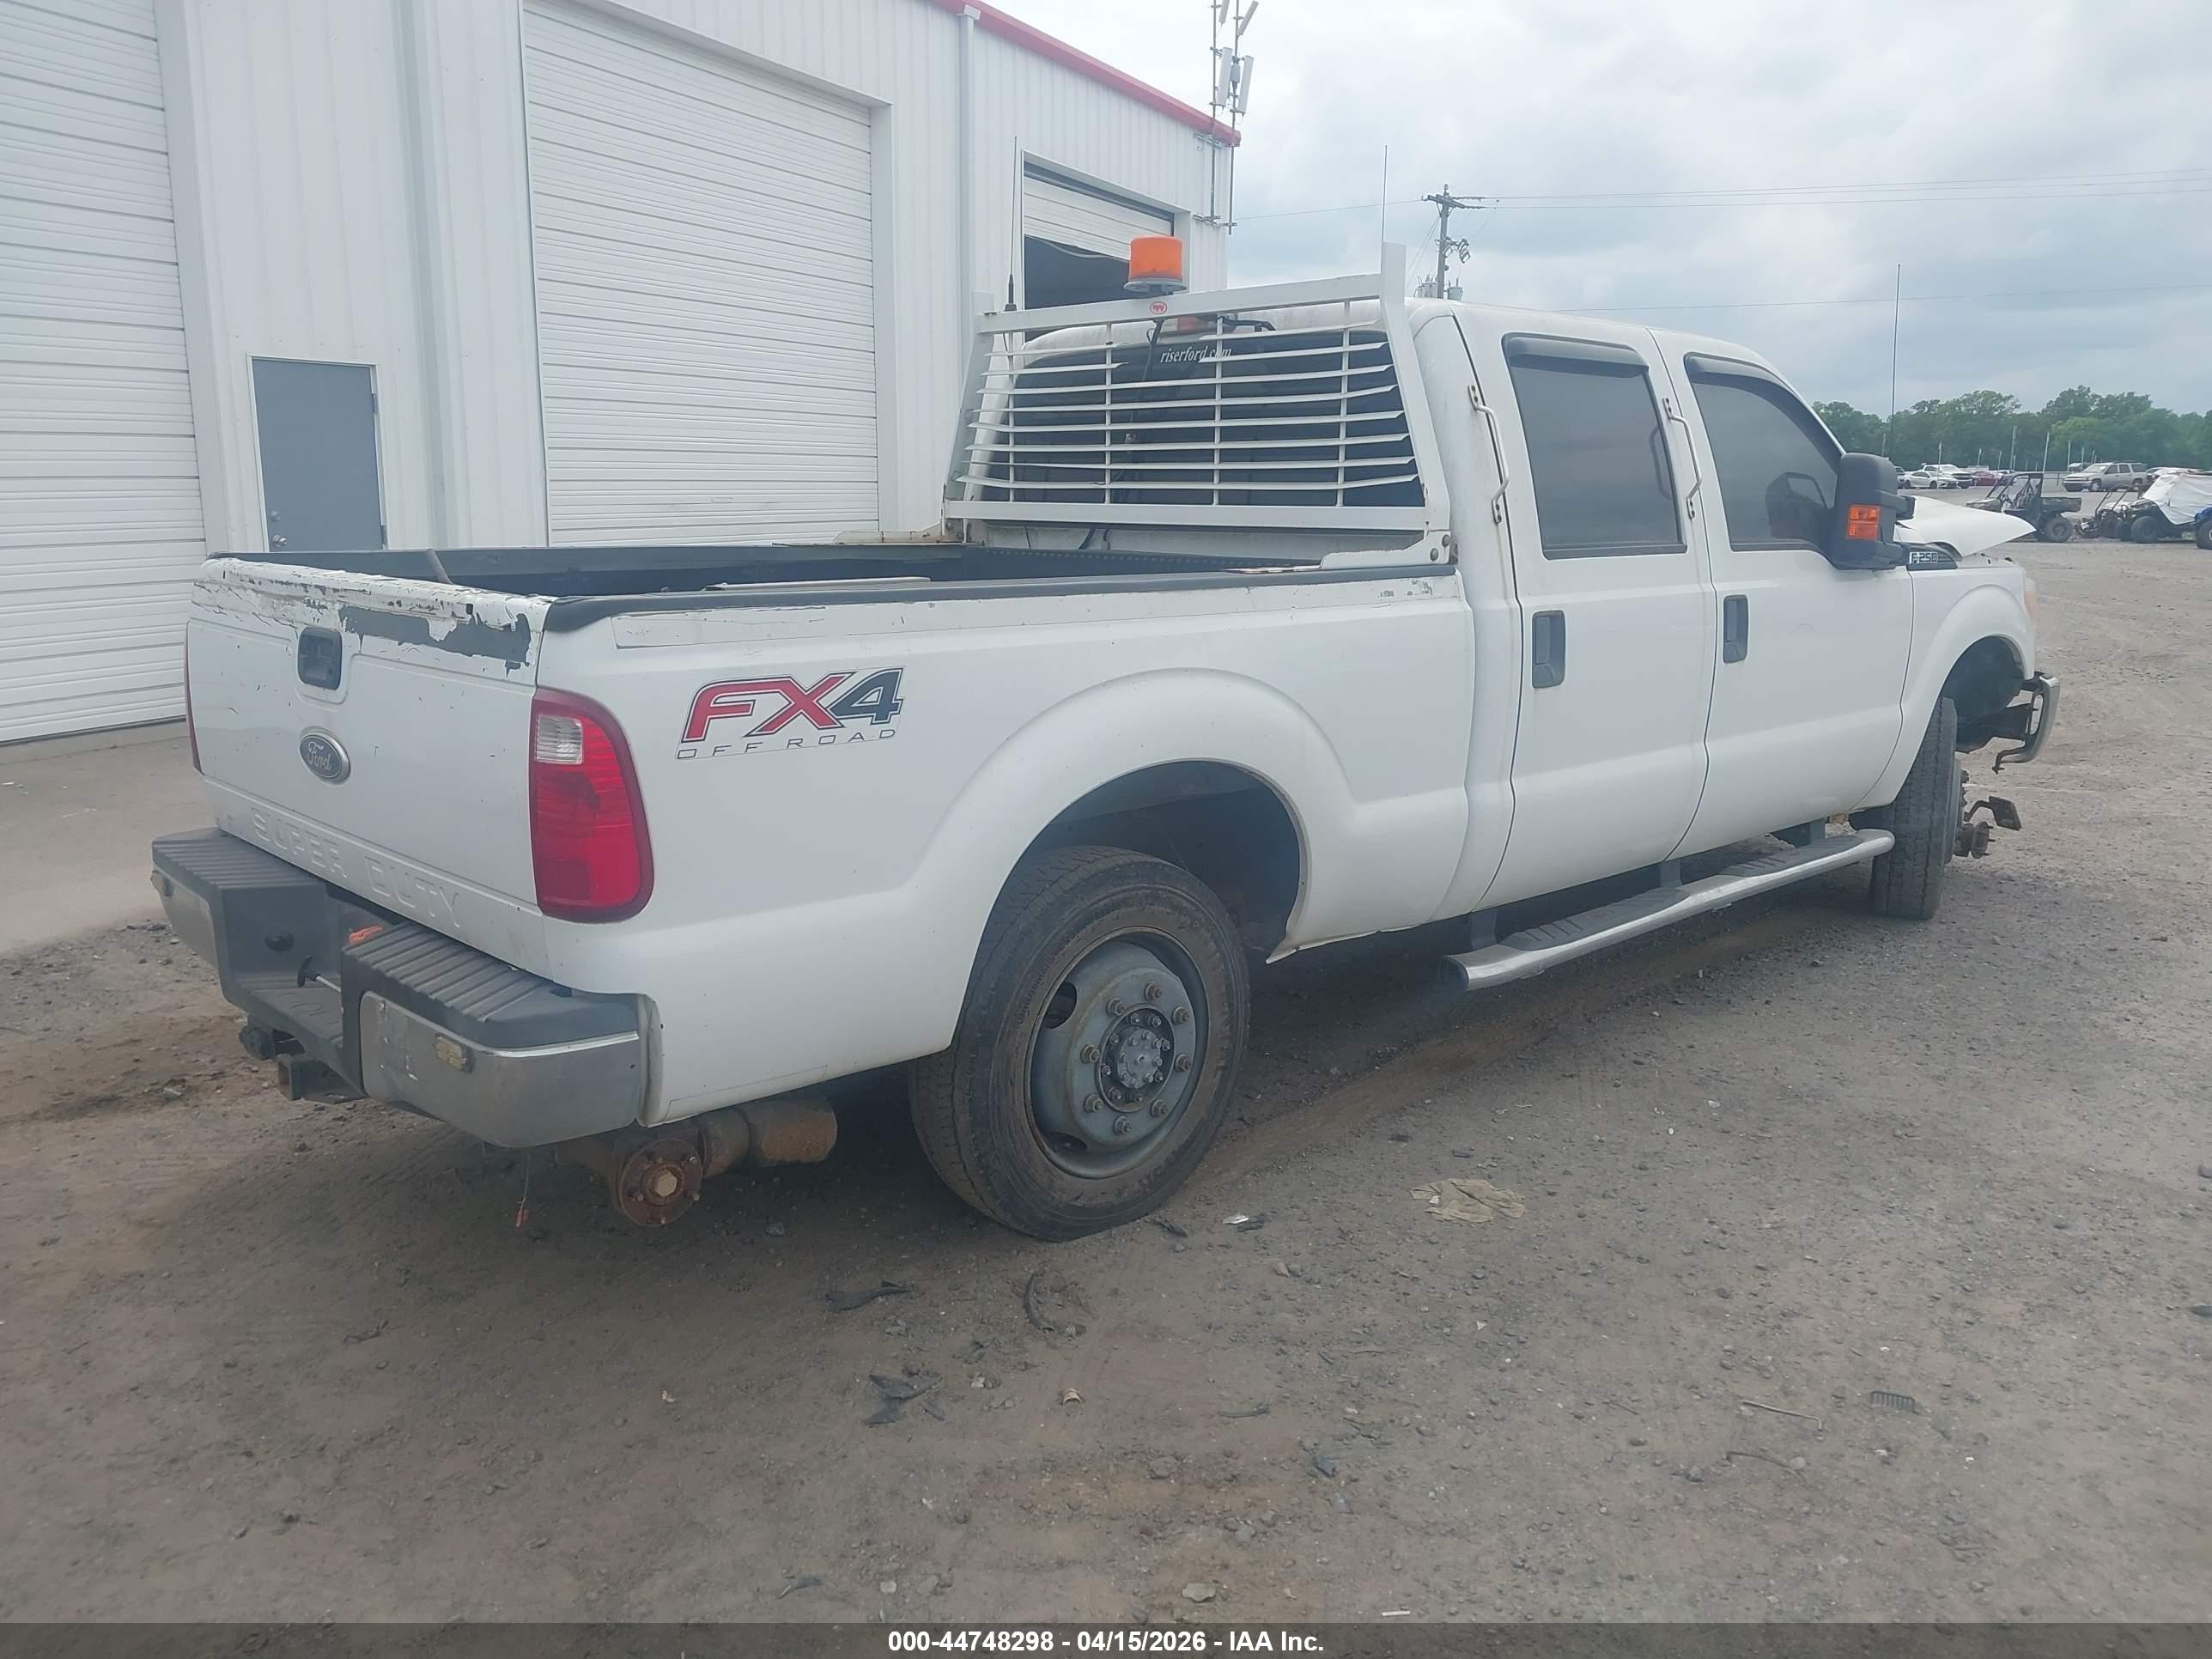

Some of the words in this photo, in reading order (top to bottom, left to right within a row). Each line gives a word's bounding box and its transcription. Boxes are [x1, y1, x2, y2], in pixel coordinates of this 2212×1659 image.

[1160, 345, 1231, 363] riserford.cm
[681, 667, 904, 743] FX4
[308, 741, 331, 770] Ford
[250, 807, 350, 879] SUPER
[364, 855, 461, 928] DUTY
